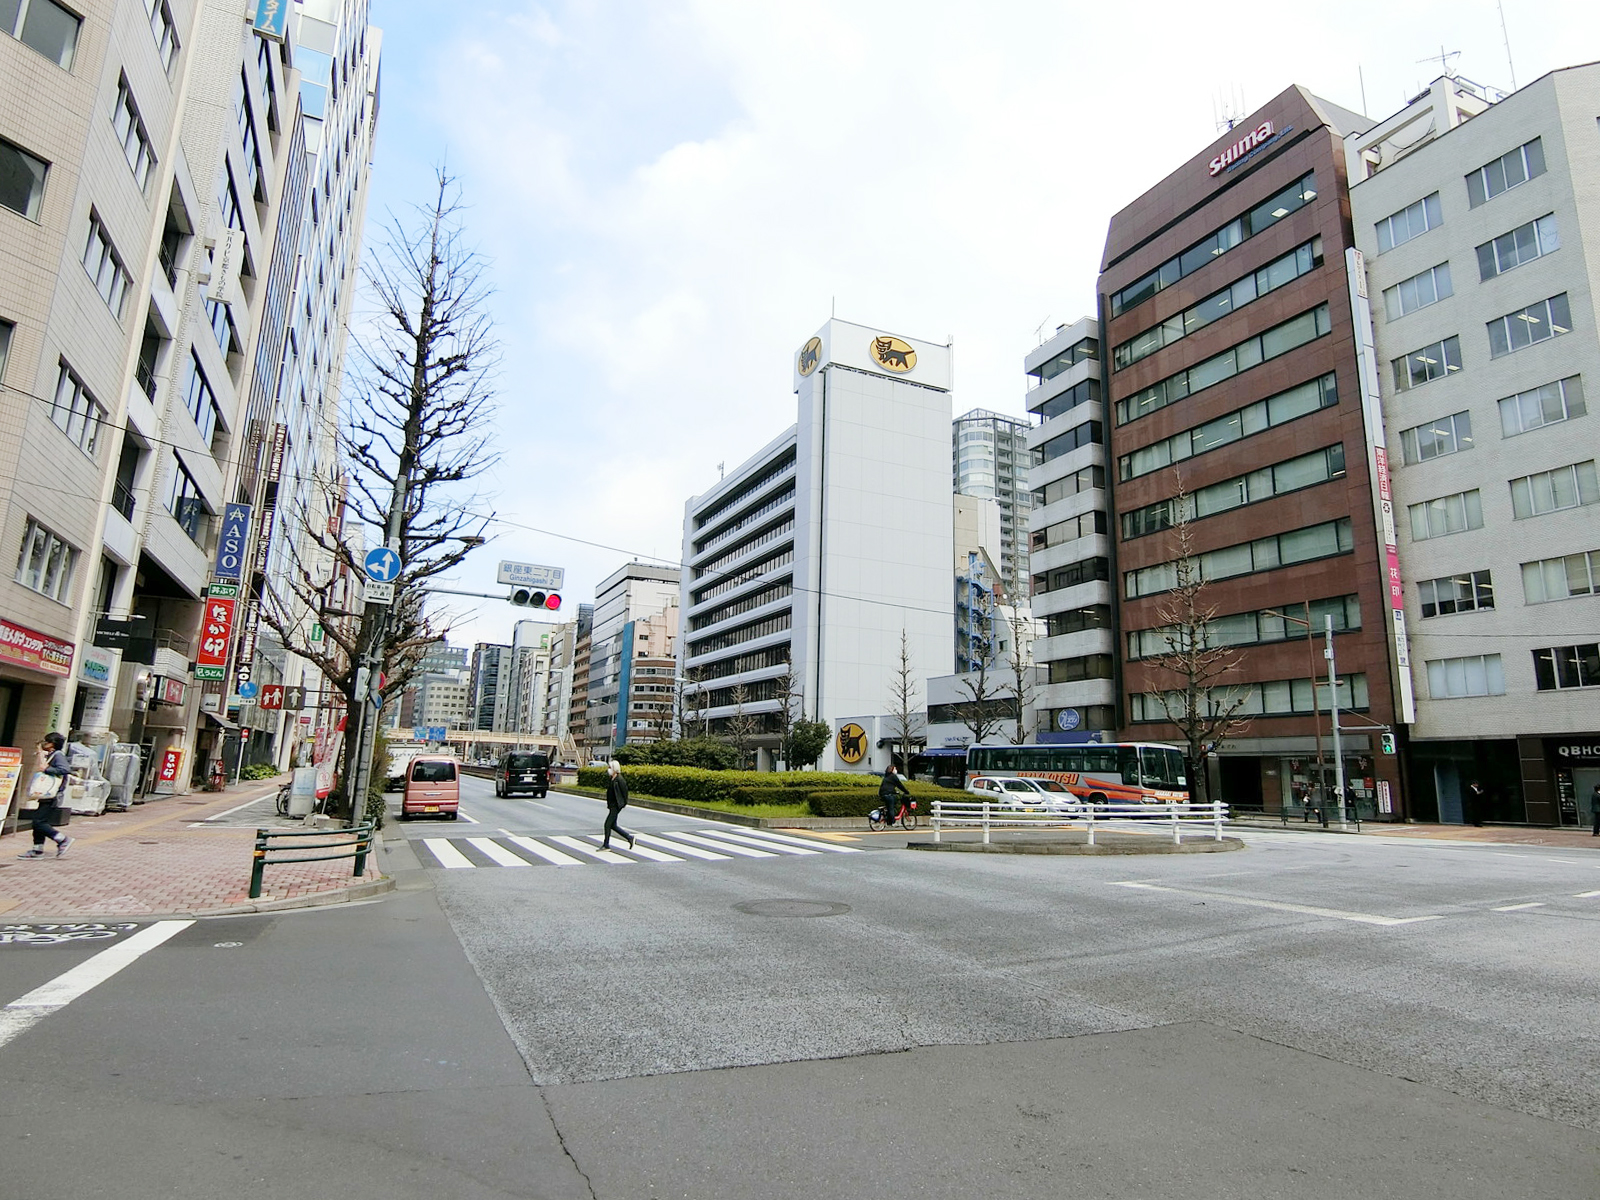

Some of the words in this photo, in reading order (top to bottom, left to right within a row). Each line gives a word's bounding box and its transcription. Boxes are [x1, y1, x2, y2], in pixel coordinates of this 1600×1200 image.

[221, 523, 242, 569] ASO
[503, 562, 561, 579] 銀座東二丁目
[509, 573, 548, 585] Ginzahigashi
[211, 586, 235, 596] 丼ぶり
[366, 590, 391, 598] 一方通行
[203, 604, 228, 658] なか卯
[163, 753, 176, 779] なか卯
